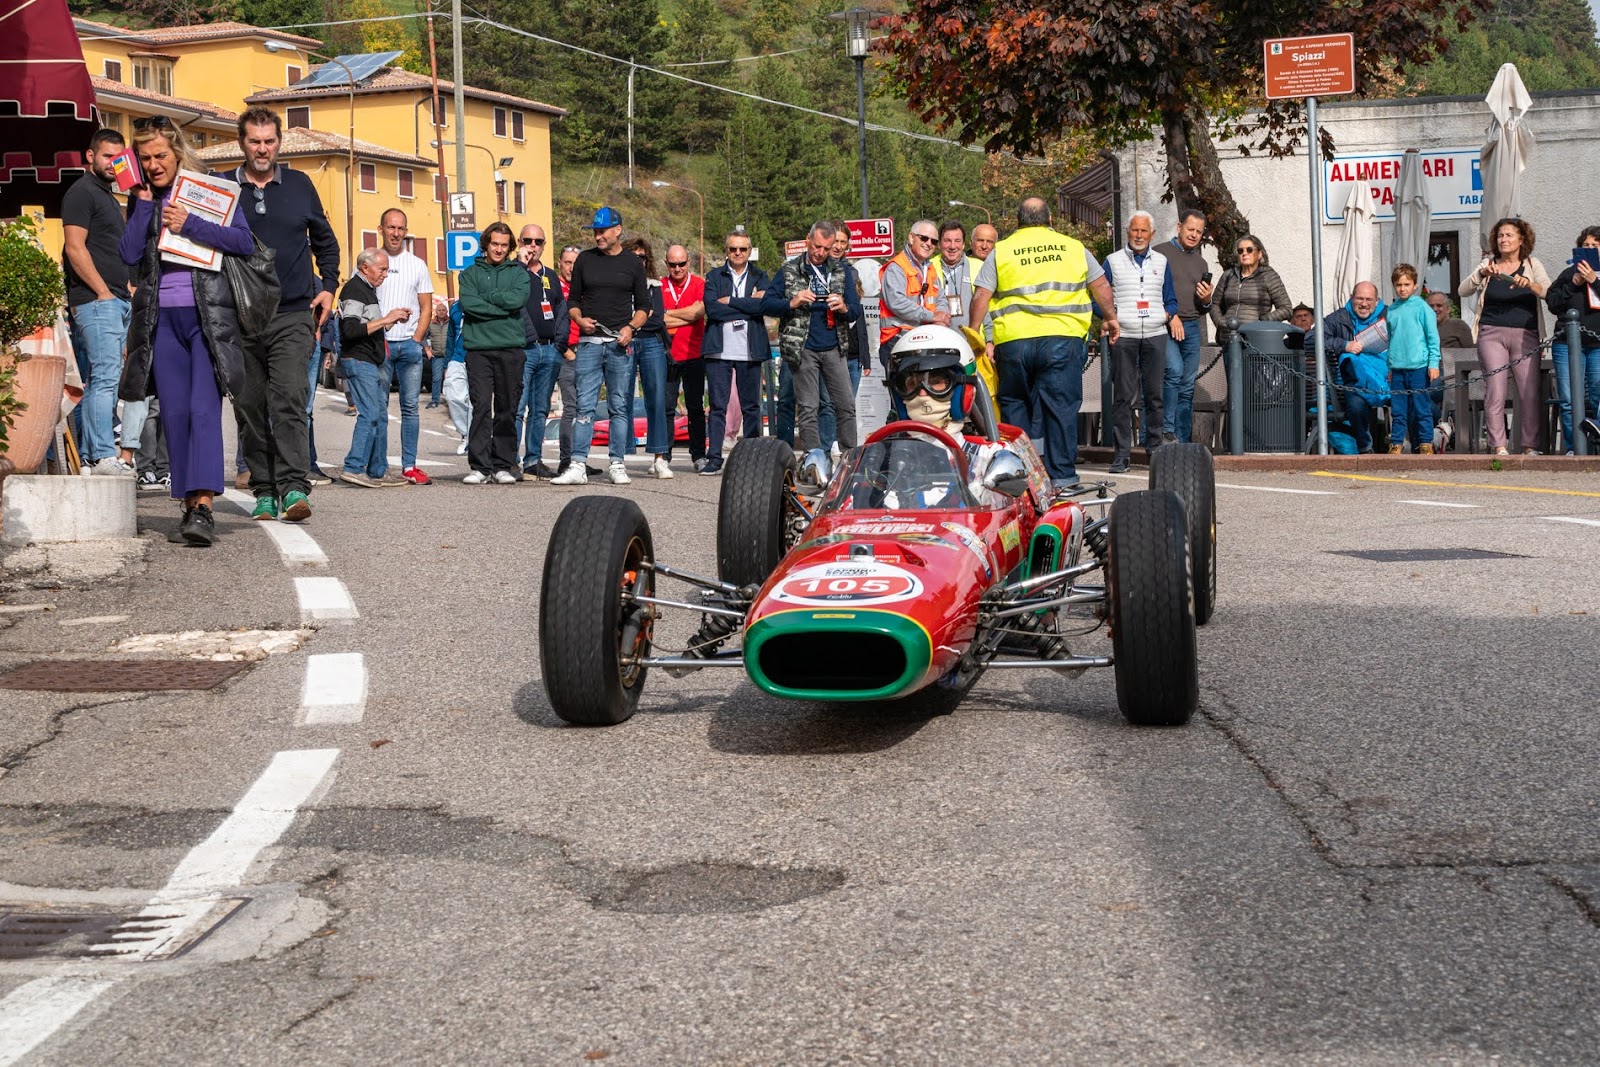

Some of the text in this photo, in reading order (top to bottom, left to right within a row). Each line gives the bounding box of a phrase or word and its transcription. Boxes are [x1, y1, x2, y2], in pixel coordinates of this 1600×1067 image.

[1291, 51, 1326, 62] Spiazzi
[1330, 159, 1454, 182] ALIMENARI
[455, 235, 479, 267] P
[1013, 244, 1067, 256] UFFICIALE
[1020, 254, 1063, 266] DI GARA
[800, 578, 890, 594] 105
